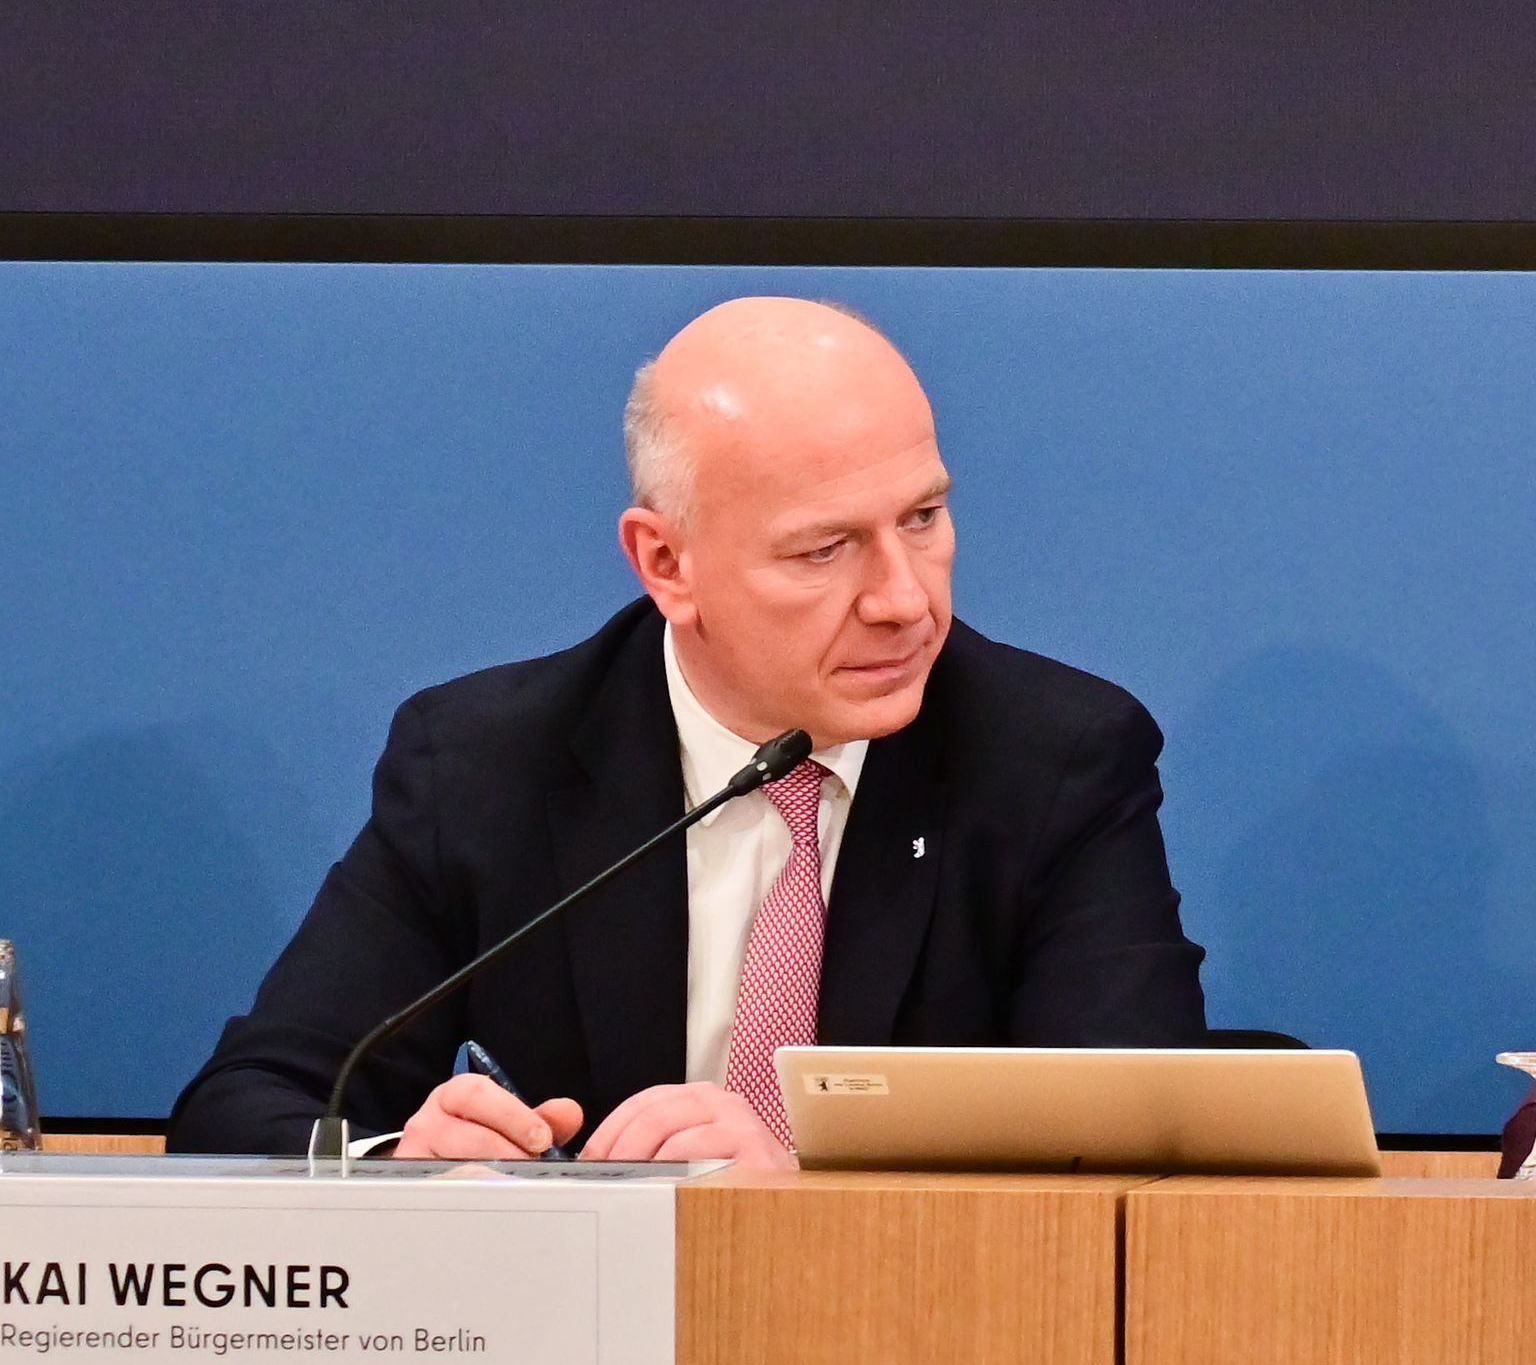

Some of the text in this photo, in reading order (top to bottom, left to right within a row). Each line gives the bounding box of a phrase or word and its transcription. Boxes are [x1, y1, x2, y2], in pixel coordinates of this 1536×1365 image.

[3, 1262, 350, 1309] KAI WEGNER
[1, 1323, 486, 1356] Regierender Bürgermeister von Berlin
